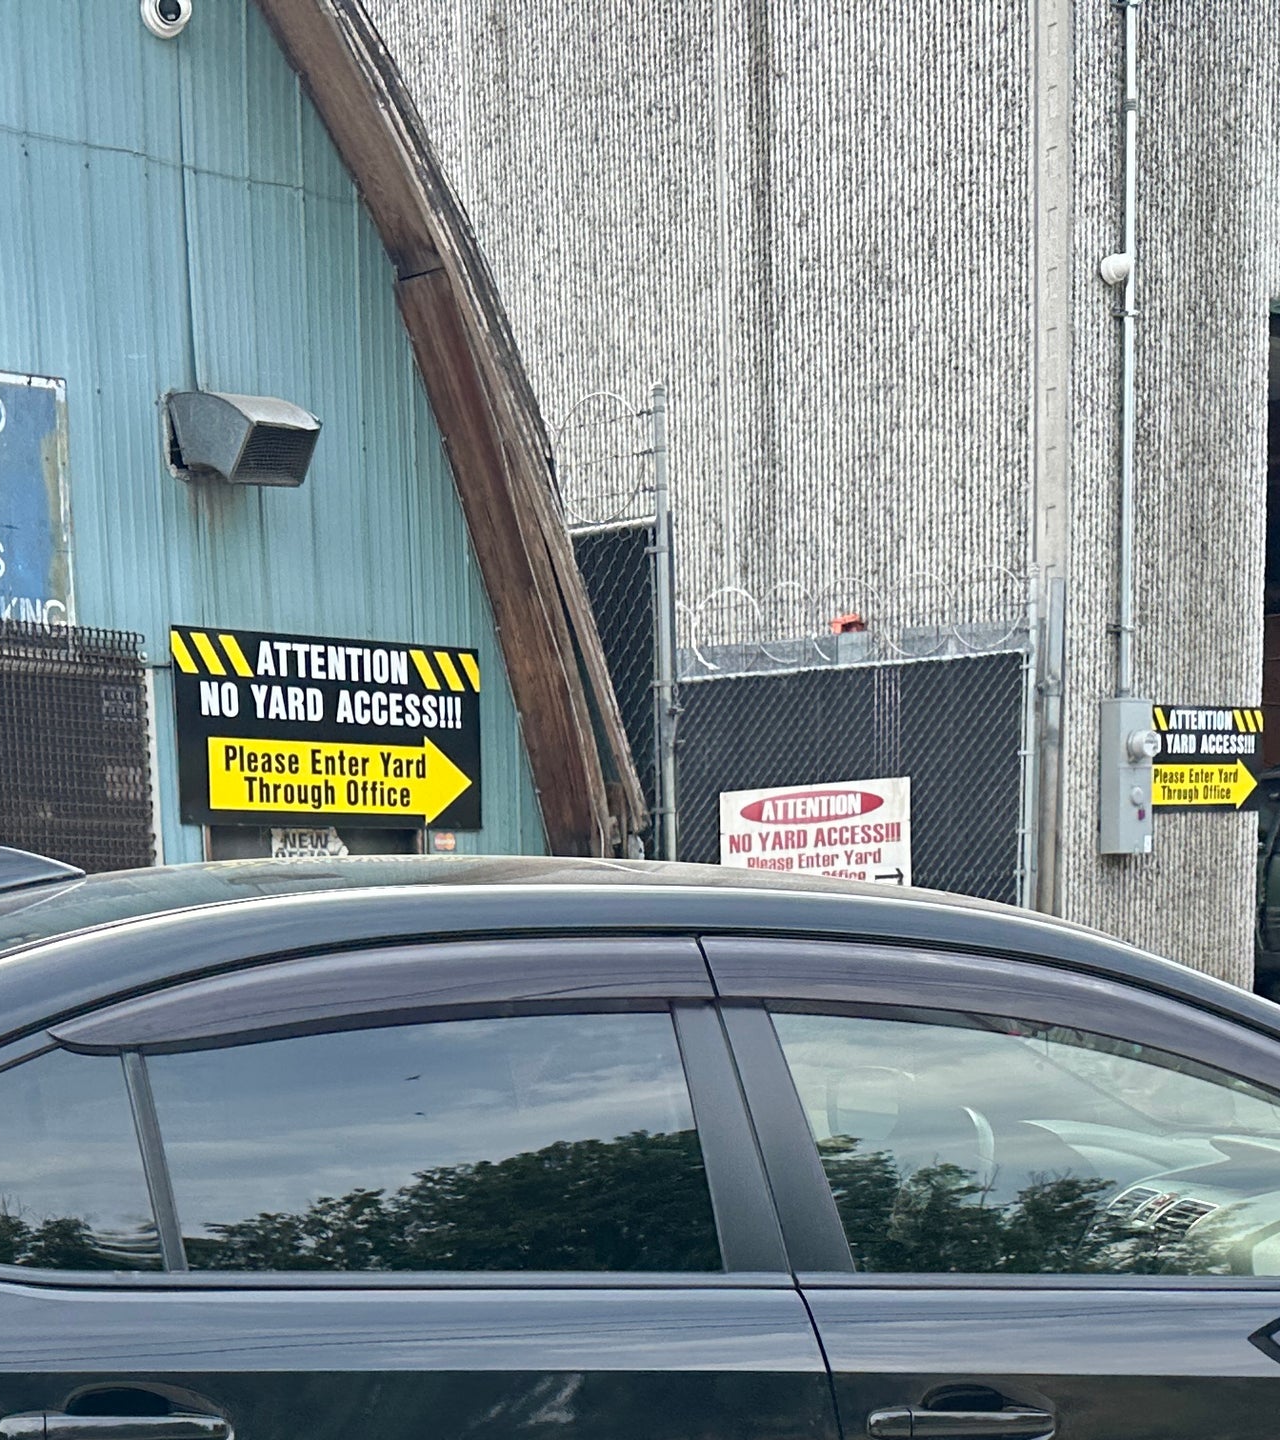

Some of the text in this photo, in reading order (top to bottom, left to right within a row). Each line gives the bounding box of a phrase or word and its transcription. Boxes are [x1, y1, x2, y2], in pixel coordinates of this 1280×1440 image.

[256, 641, 409, 685] ATTENTION
[200, 681, 462, 729] NO YARD ACCESS!!!
[1169, 709, 1233, 731] ATTENTION
[1165, 734, 1197, 754] YARD
[1200, 734, 1255, 754] ACCESS!!!
[224, 745, 427, 779] Please Enter Yard
[1153, 768, 1238, 784] Please Enter Yard
[243, 776, 411, 809] Through Office
[1161, 785, 1231, 802] Through Office
[761, 793, 862, 822] ATTENTION
[283, 831, 329, 849] NEW
[729, 822, 901, 854] NO YARD ACCESS!!!
[798, 853, 839, 869] Enter
[844, 848, 881, 866] Yard
